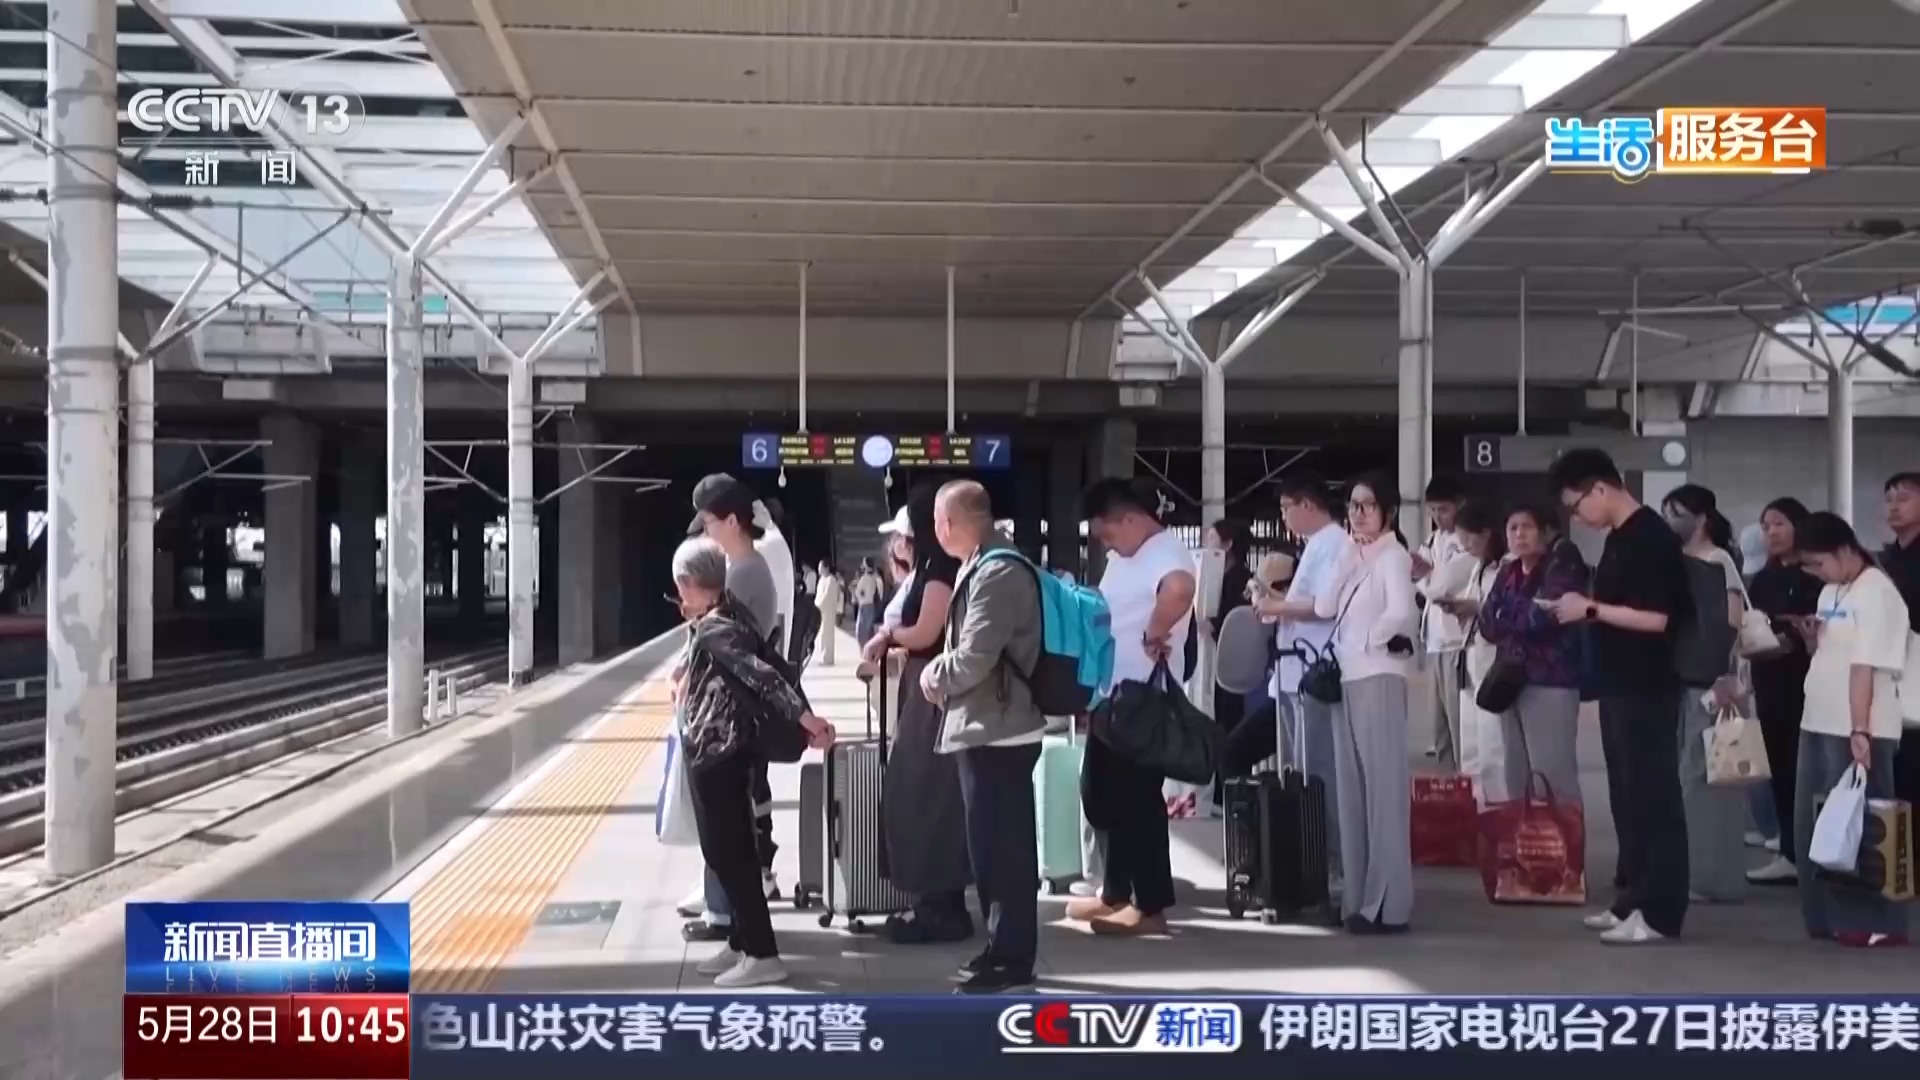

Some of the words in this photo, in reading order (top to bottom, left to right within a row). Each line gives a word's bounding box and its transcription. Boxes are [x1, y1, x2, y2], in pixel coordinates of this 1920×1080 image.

[751, 437, 768, 463] 6
[985, 439, 1001, 463] 7
[1476, 440, 1493, 466] 8
